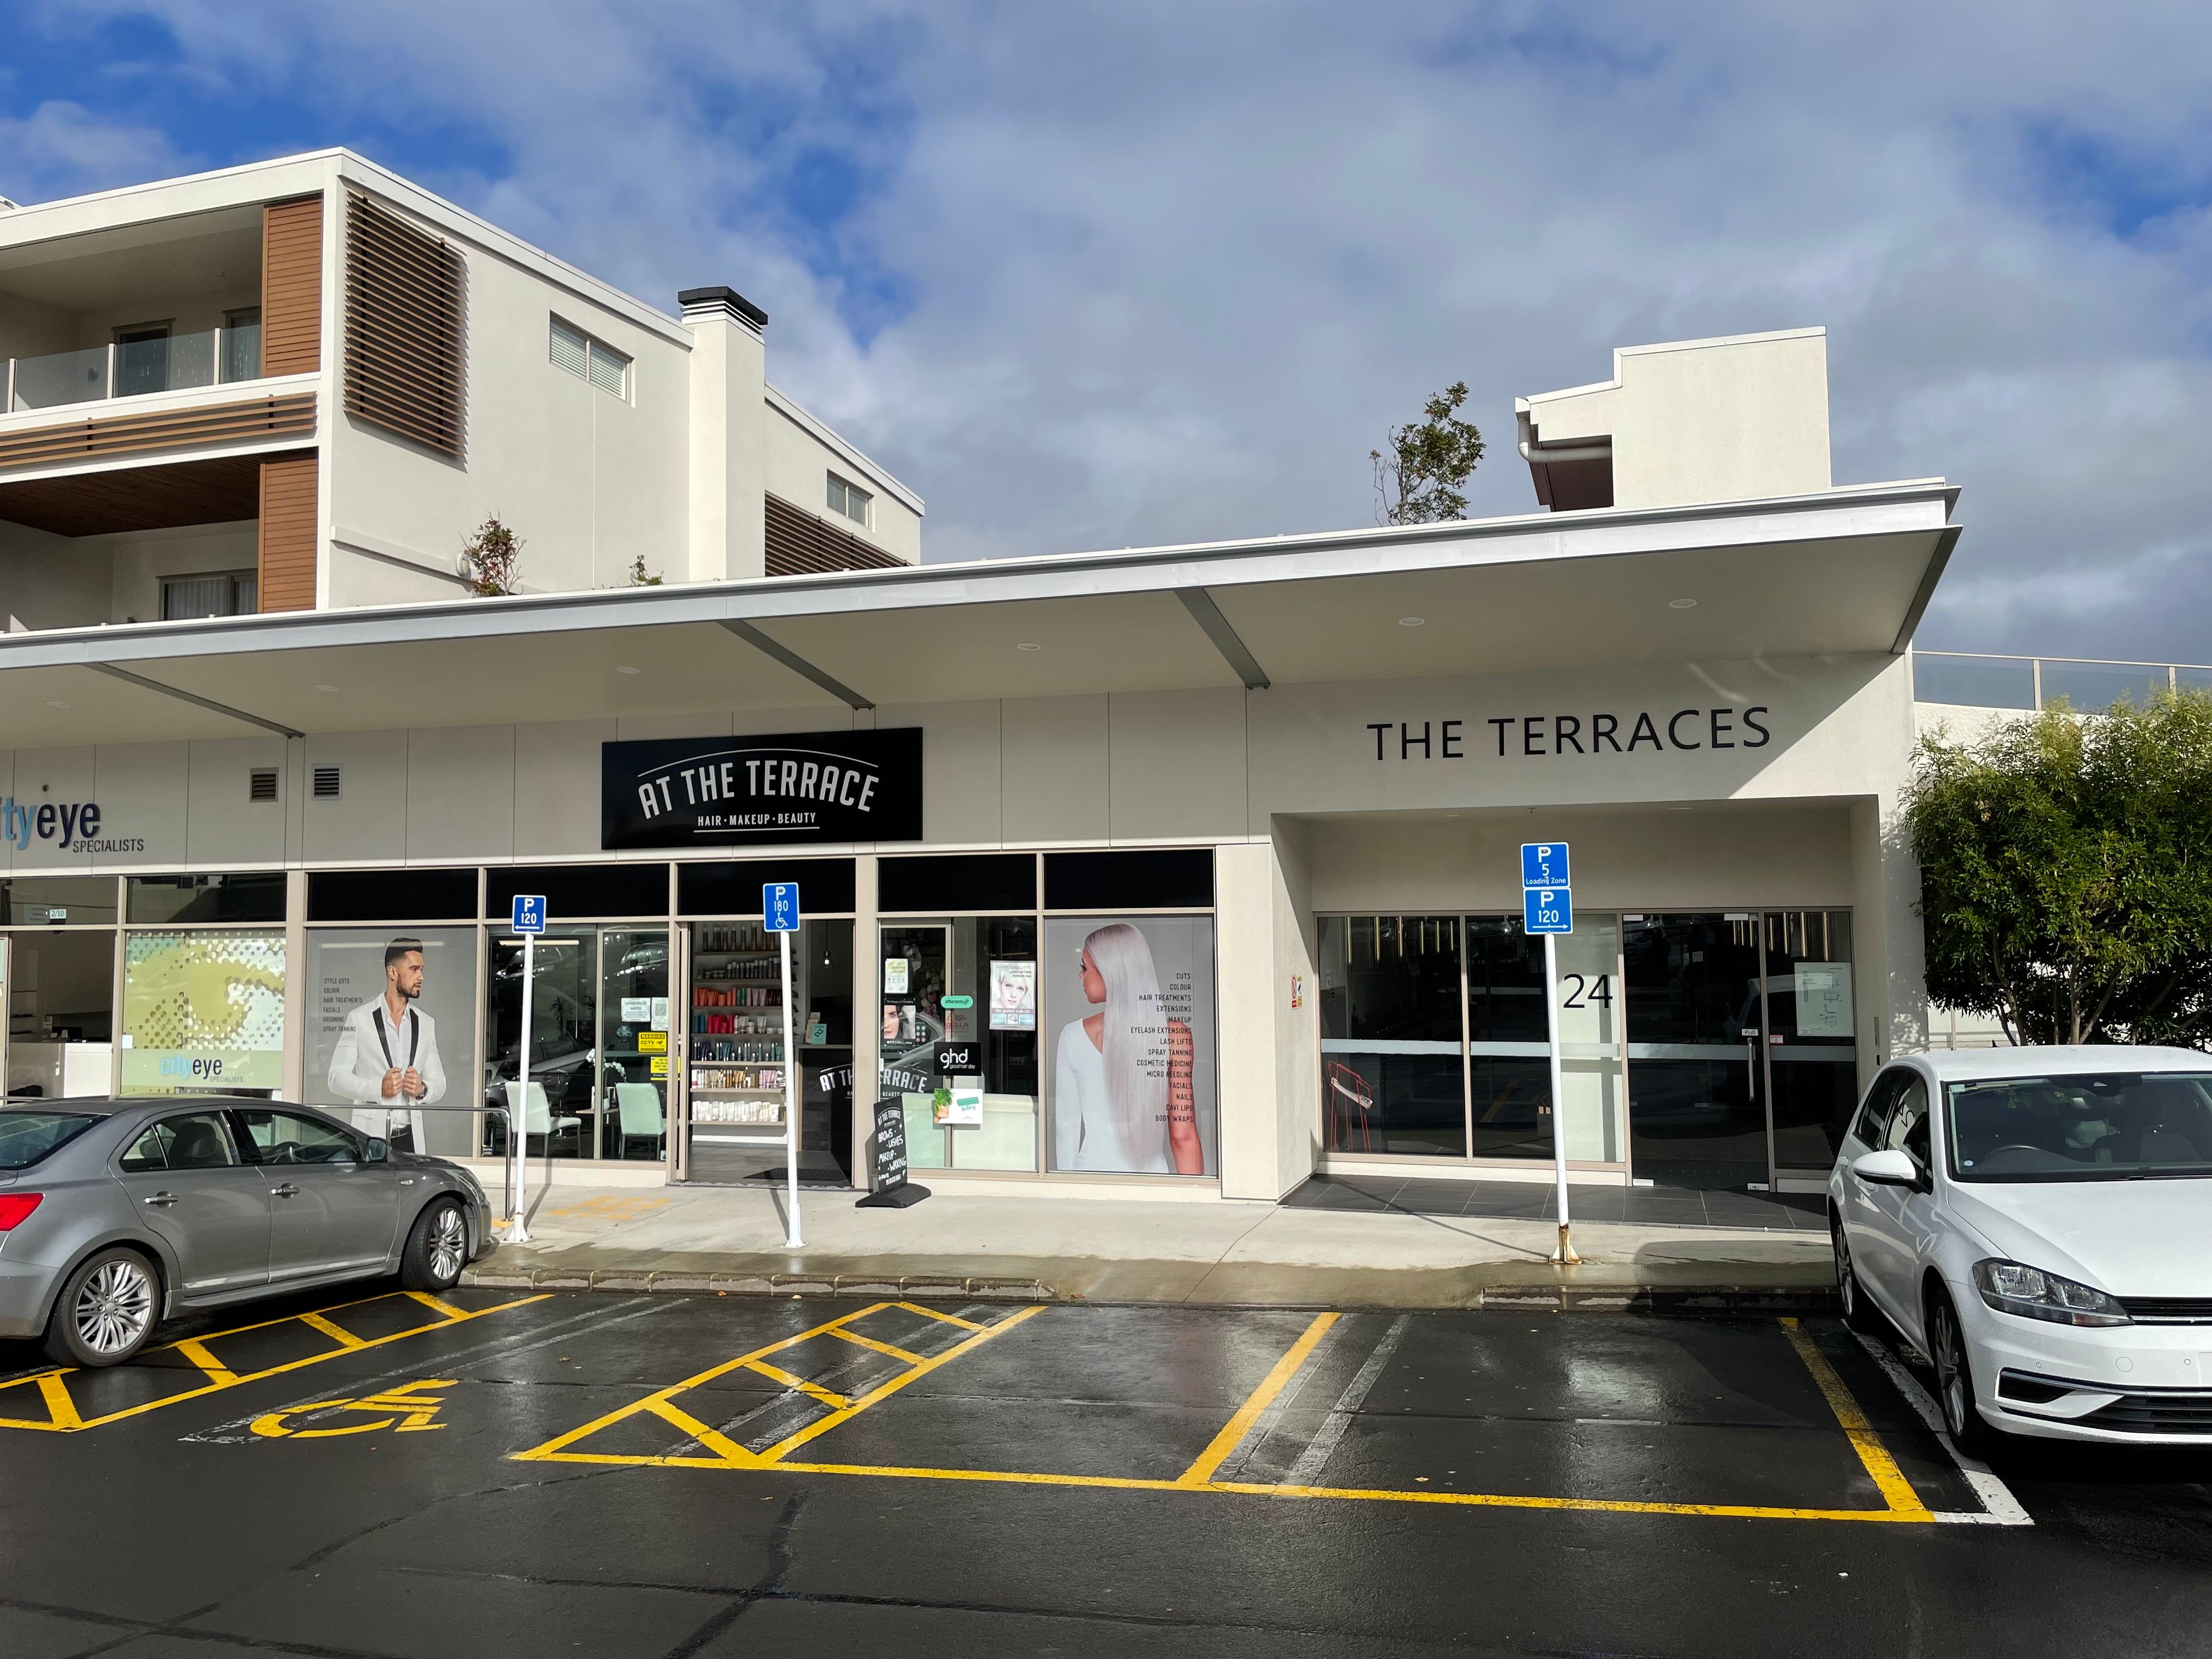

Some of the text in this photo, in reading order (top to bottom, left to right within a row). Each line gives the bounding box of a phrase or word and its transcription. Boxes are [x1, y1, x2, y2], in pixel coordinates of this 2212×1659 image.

[1367, 707, 1770, 761] THE TERRACES
[637, 760, 879, 820] AT THE TERRACE
[0, 797, 101, 850] tyeye
[697, 812, 816, 827] HAIR MAKEUP BEAUTY
[73, 839, 144, 853] SPECIALISTS
[1538, 846, 1552, 863] P
[1542, 863, 1550, 876] 5
[775, 886, 786, 901] P
[1541, 891, 1554, 908] P
[524, 898, 535, 912] P
[774, 900, 788, 912] 180
[521, 912, 537, 924] 120
[1538, 910, 1559, 923] 120
[1563, 973, 1613, 1008] 24
[940, 1048, 968, 1069] ghd
[820, 1072, 836, 1092] AT
[878, 1128, 893, 1143] BROWS
[878, 1149, 894, 1164] MAKEUP
[889, 1155, 906, 1172] WAXING
